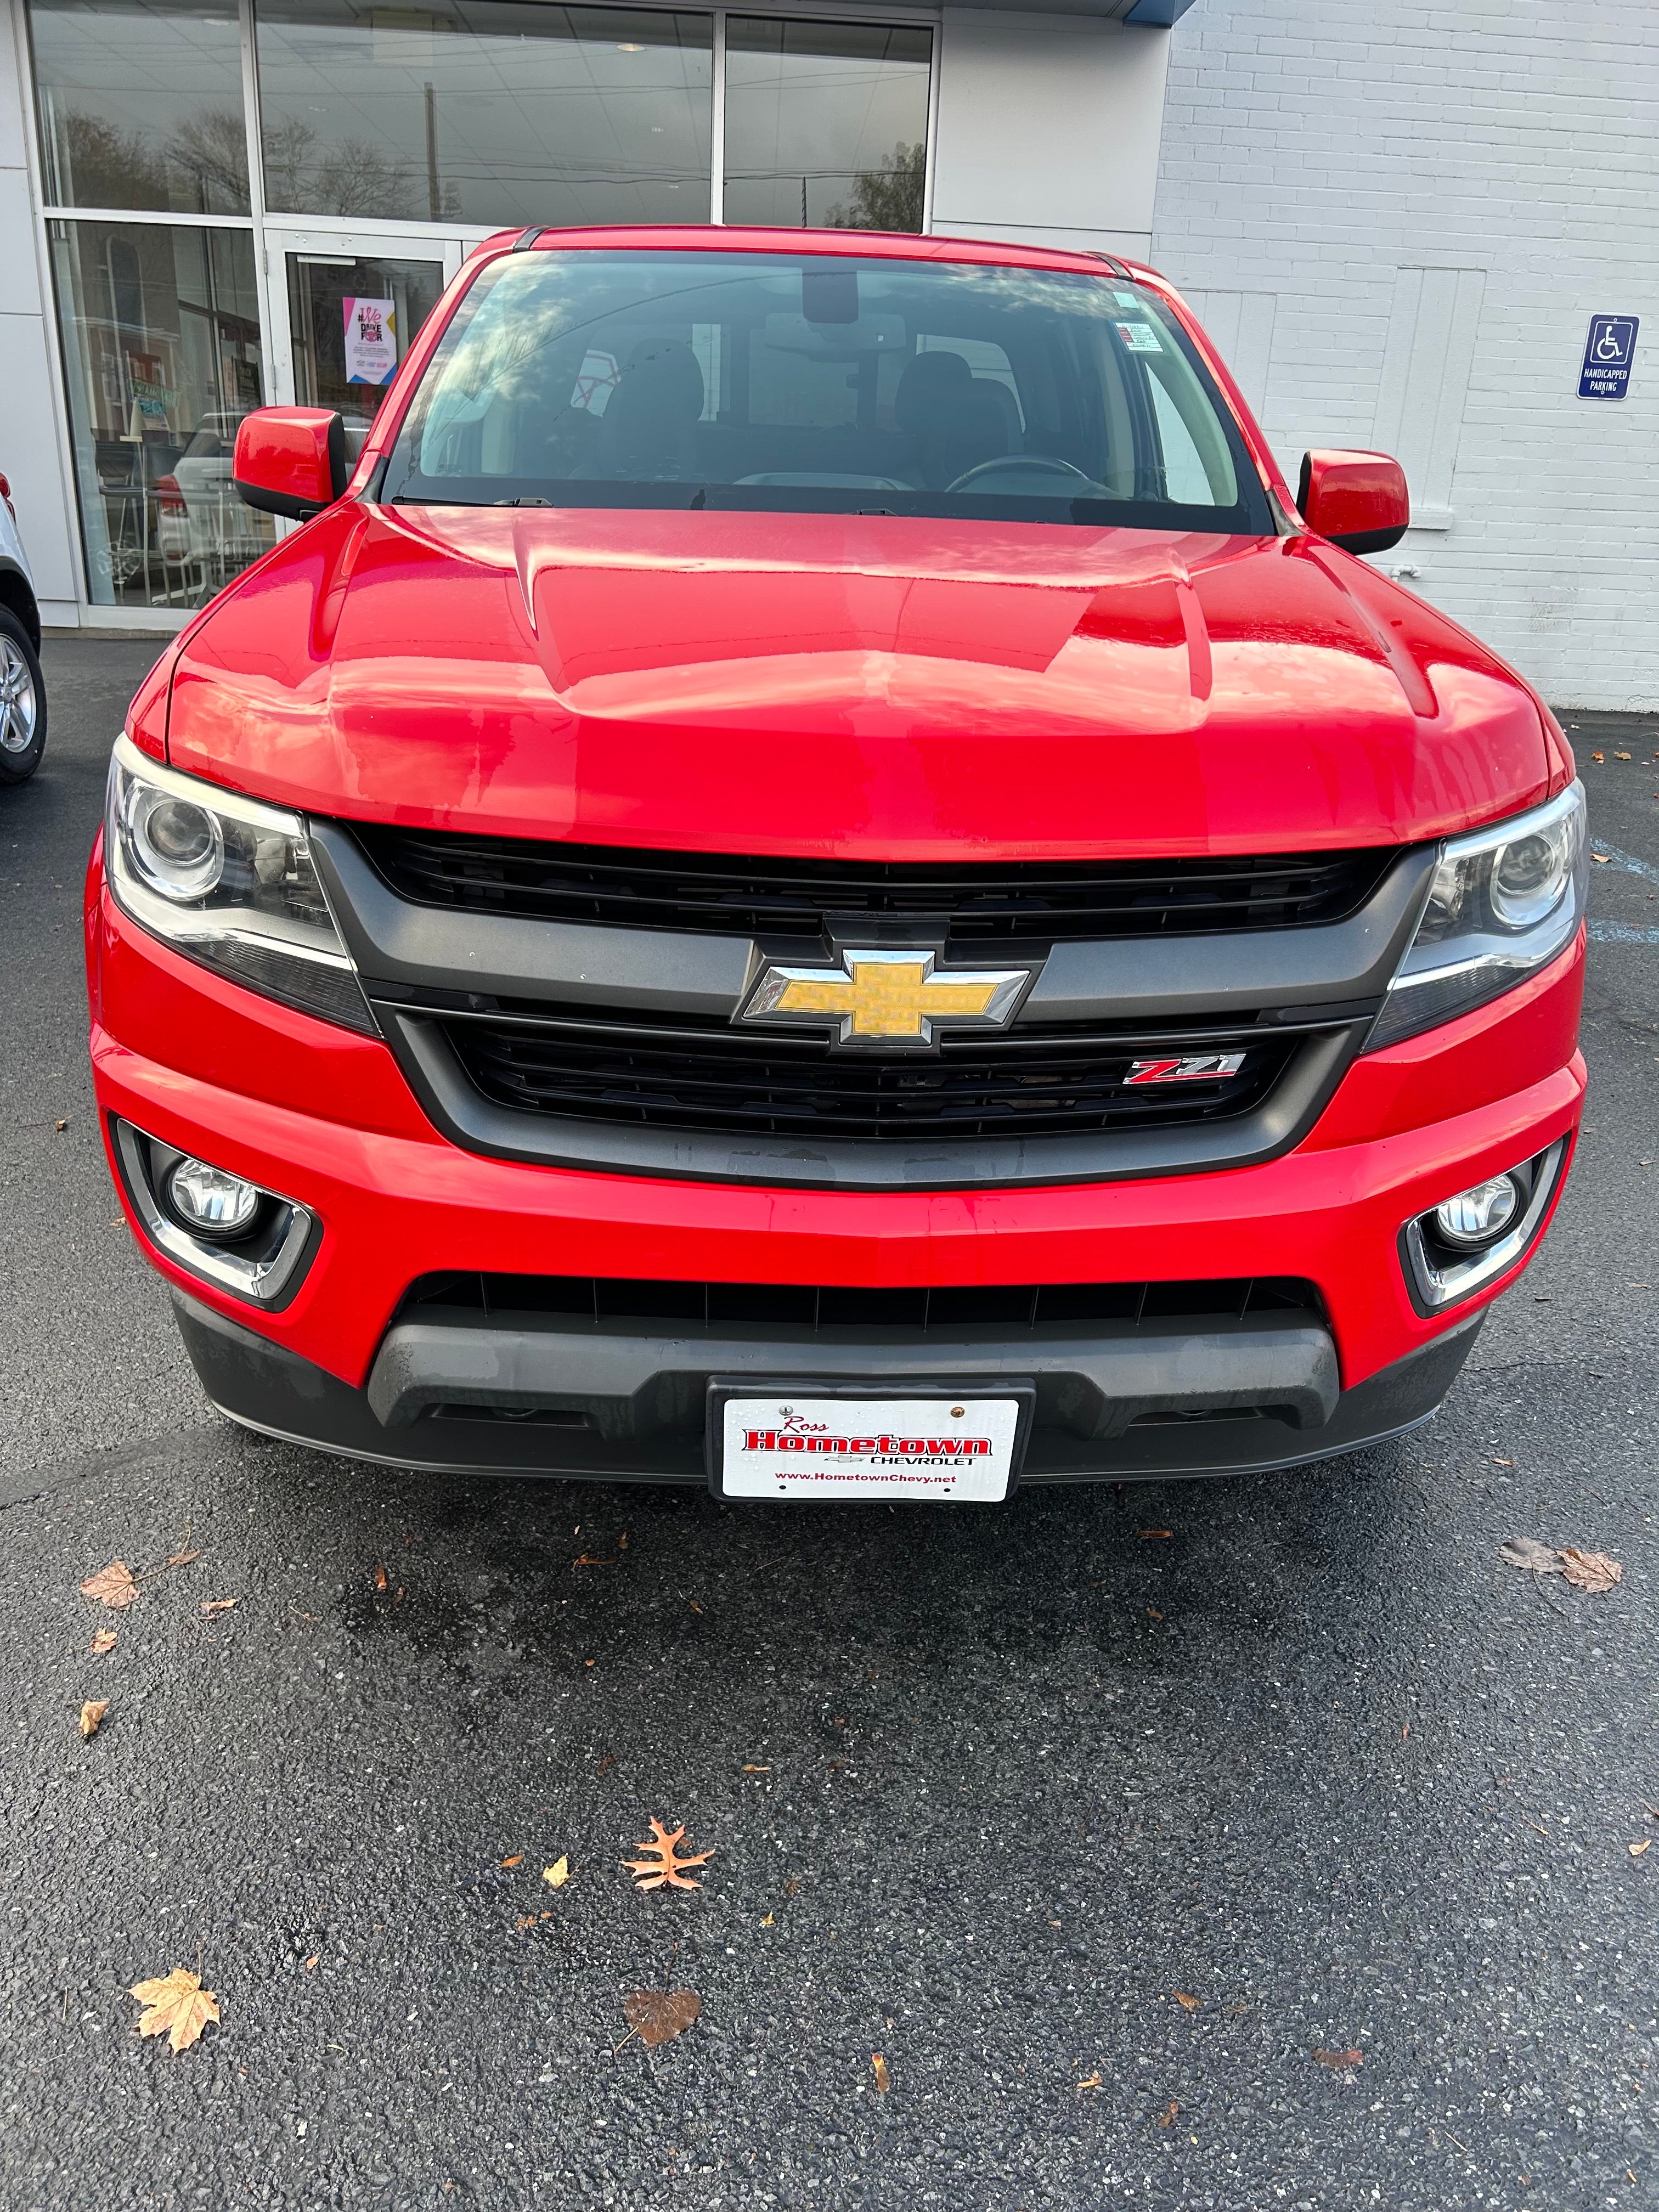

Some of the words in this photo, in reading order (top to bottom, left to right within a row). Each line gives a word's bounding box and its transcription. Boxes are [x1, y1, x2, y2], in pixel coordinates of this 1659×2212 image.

[360, 323, 382, 332] DRIVE
[1584, 369, 1628, 380] HANDICAPPED
[1589, 381, 1617, 391] PARKING
[1122, 1053, 1246, 1084] Z71
[783, 1416, 829, 1433] Ross
[742, 1429, 993, 1456] Hometown
[871, 1457, 977, 1465] CHEVROLET
[775, 1472, 956, 1483] www.HometownChevy.net
